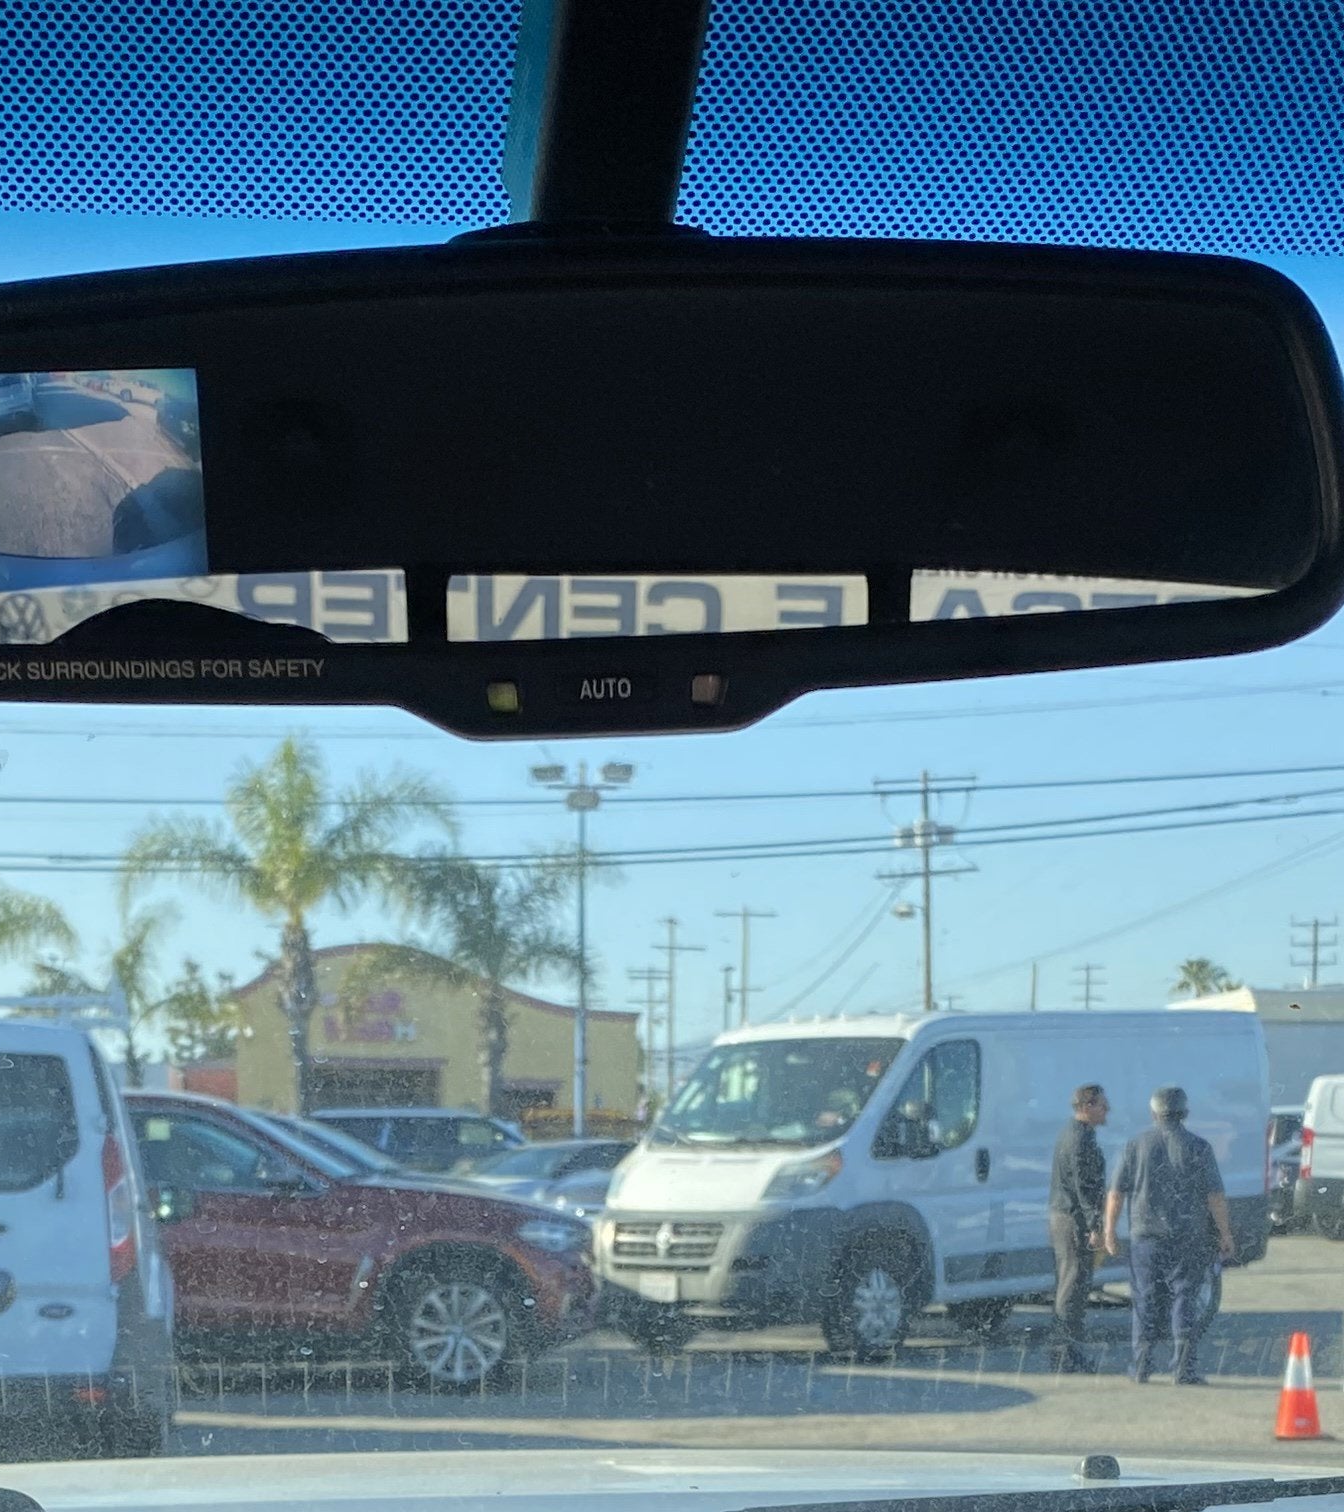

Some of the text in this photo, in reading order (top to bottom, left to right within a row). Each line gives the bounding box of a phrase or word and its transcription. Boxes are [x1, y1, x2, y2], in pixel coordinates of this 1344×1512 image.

[26, 659, 196, 681] SURROUNDINGS
[200, 658, 245, 679] FOR
[248, 657, 326, 679] SAFETY
[579, 676, 632, 700] AUTO
